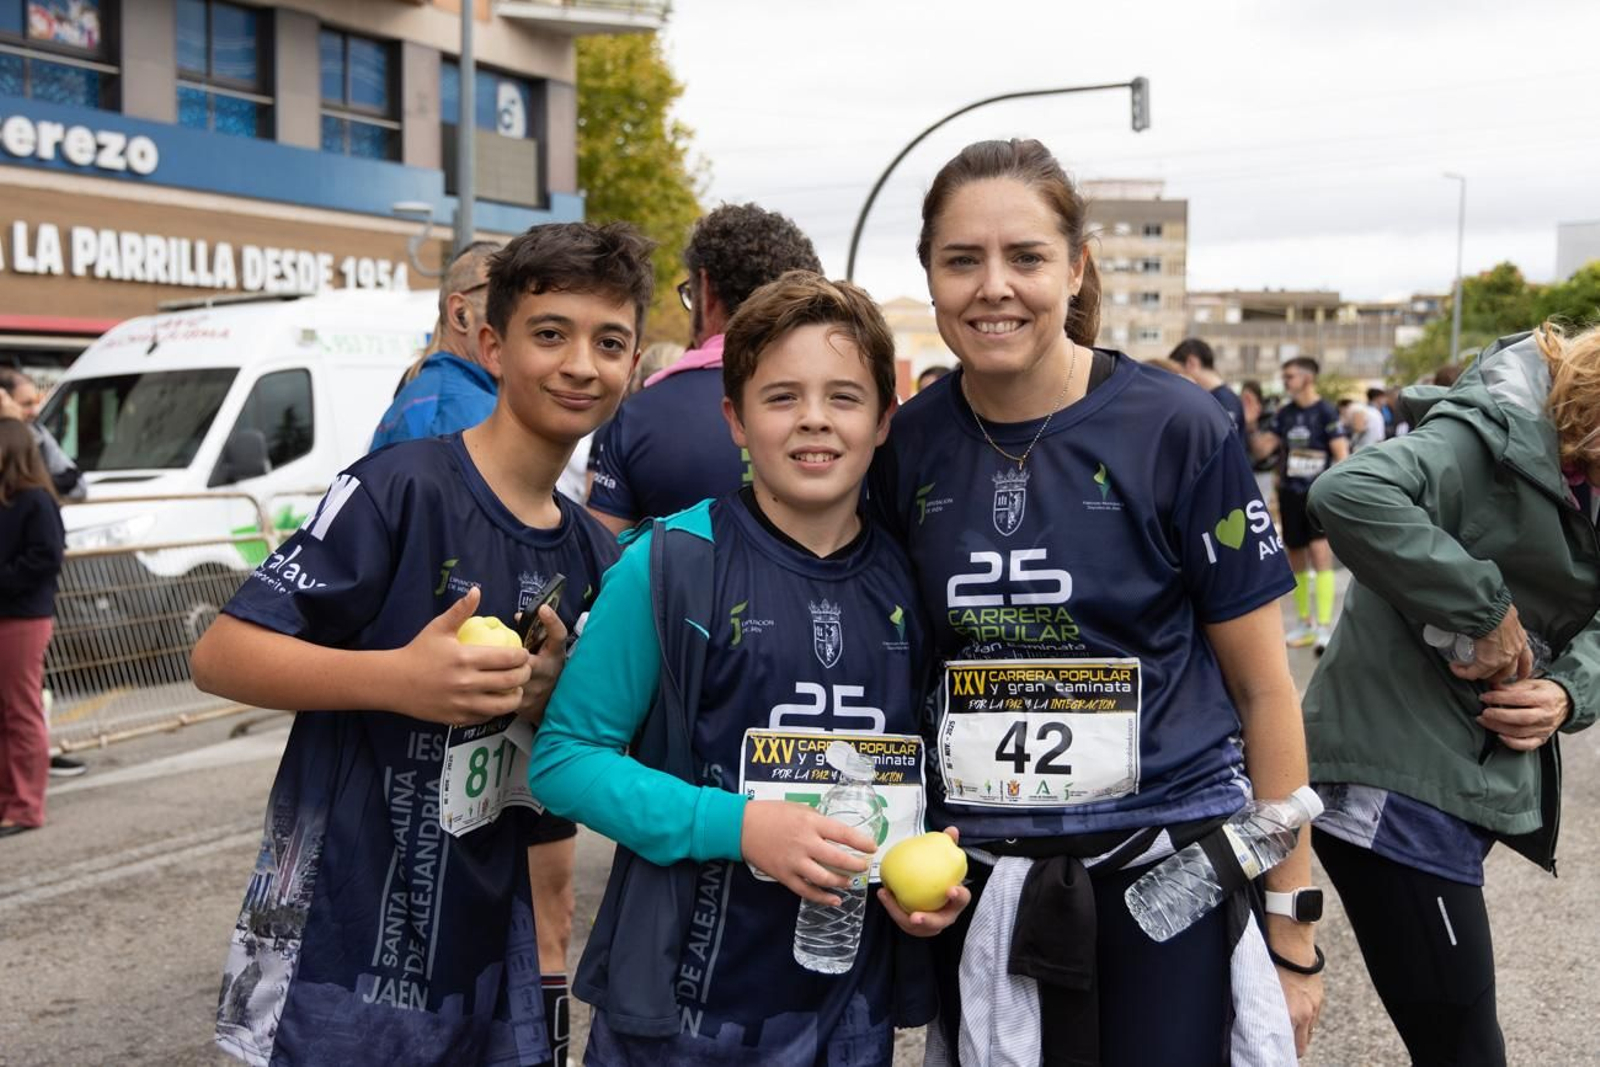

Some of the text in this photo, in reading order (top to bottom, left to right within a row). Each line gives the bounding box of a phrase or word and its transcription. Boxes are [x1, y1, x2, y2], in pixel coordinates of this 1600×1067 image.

[13, 220, 65, 275] LA
[71, 226, 237, 288] PARRILLA
[241, 244, 335, 294] DESDE
[340, 255, 410, 292] 1954
[1201, 531, 1217, 564] I
[947, 548, 1073, 608] 25
[947, 606, 1074, 626] CARRERA
[953, 669, 1131, 696] XXV CARRERA POPULAR
[990, 681, 1132, 695] y gran caminata
[769, 682, 886, 733] 25
[967, 699, 987, 710] POR
[989, 698, 1004, 710] LA
[1004, 699, 1024, 709] PAZ
[1033, 698, 1048, 710] LA
[407, 730, 444, 762] IES
[751, 737, 795, 764] XXV
[860, 743, 917, 755] POPULAR
[798, 754, 807, 765] y
[995, 720, 1073, 775] 42
[771, 768, 793, 779] POR
[794, 769, 810, 780] LA
[810, 769, 830, 780] PAZ
[382, 891, 409, 968] SANTA
[404, 939, 425, 975] DE
[363, 972, 429, 1012] JAÉN
[677, 964, 701, 1001] DE
